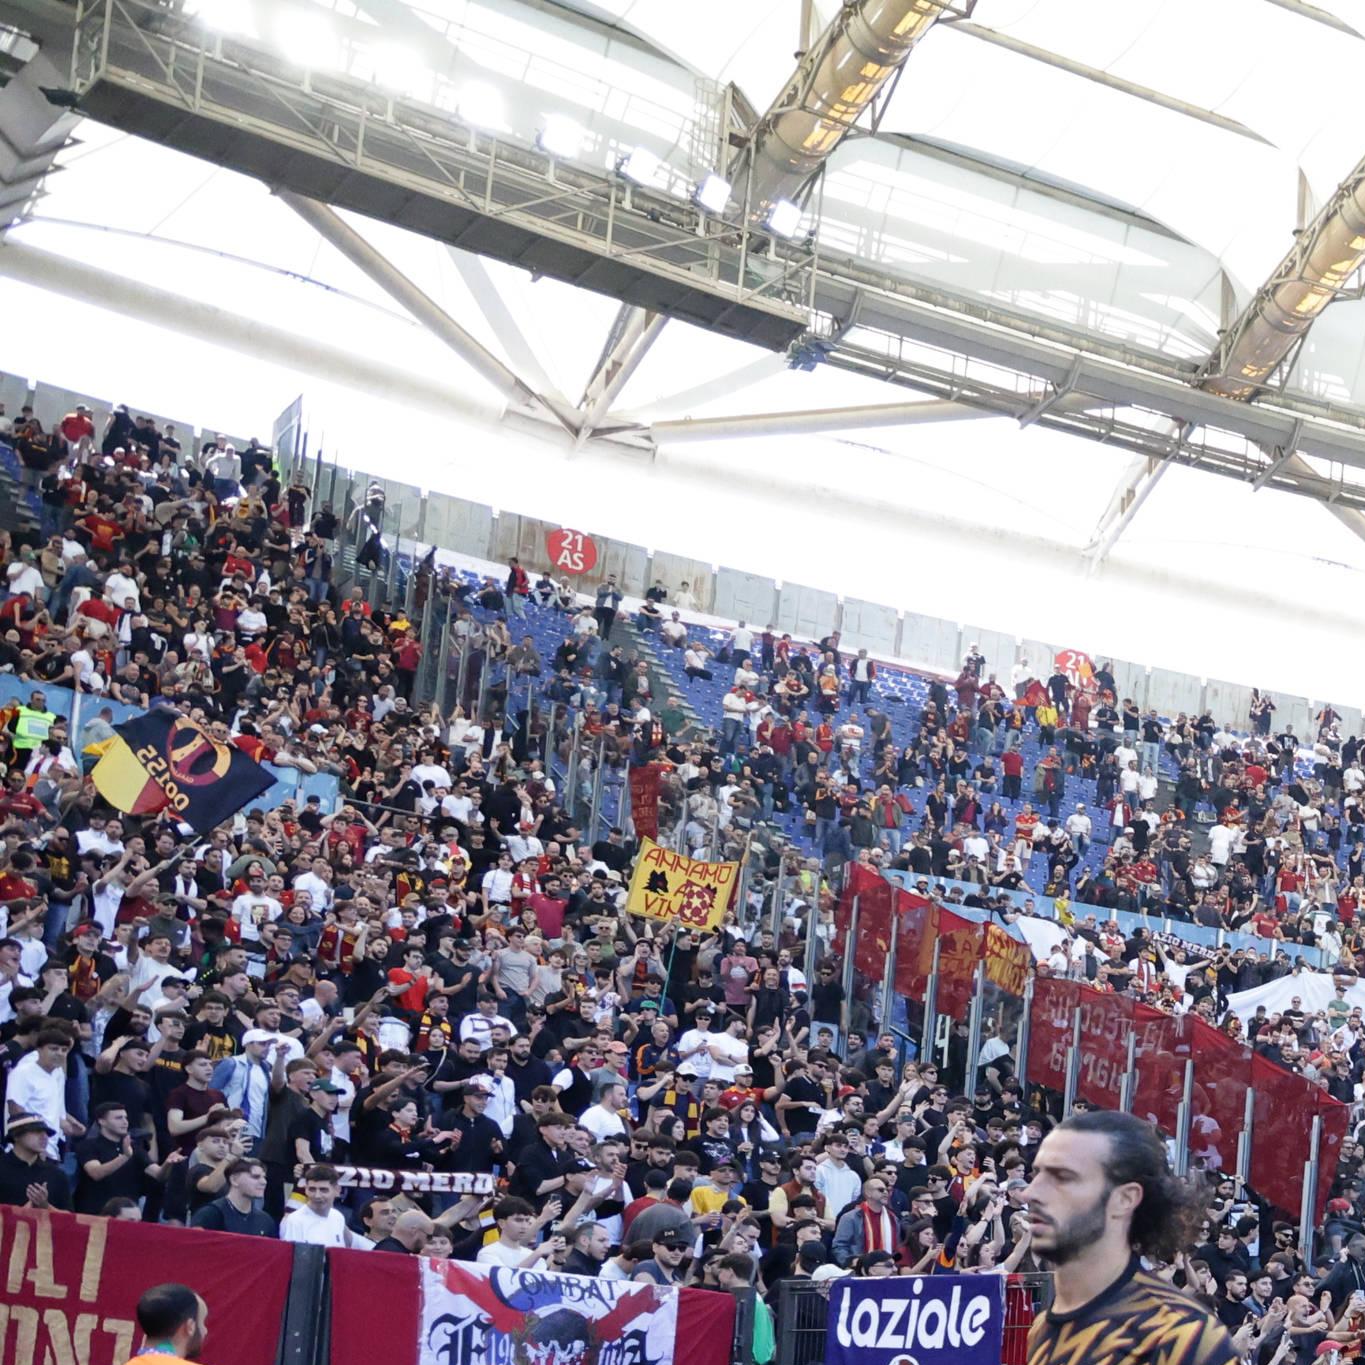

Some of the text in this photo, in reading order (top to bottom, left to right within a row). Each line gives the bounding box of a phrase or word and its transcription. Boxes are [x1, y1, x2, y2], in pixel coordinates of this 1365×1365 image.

[561, 530, 583, 552] 21
[557, 549, 584, 570] AS
[836, 1278, 991, 1349] laziale
